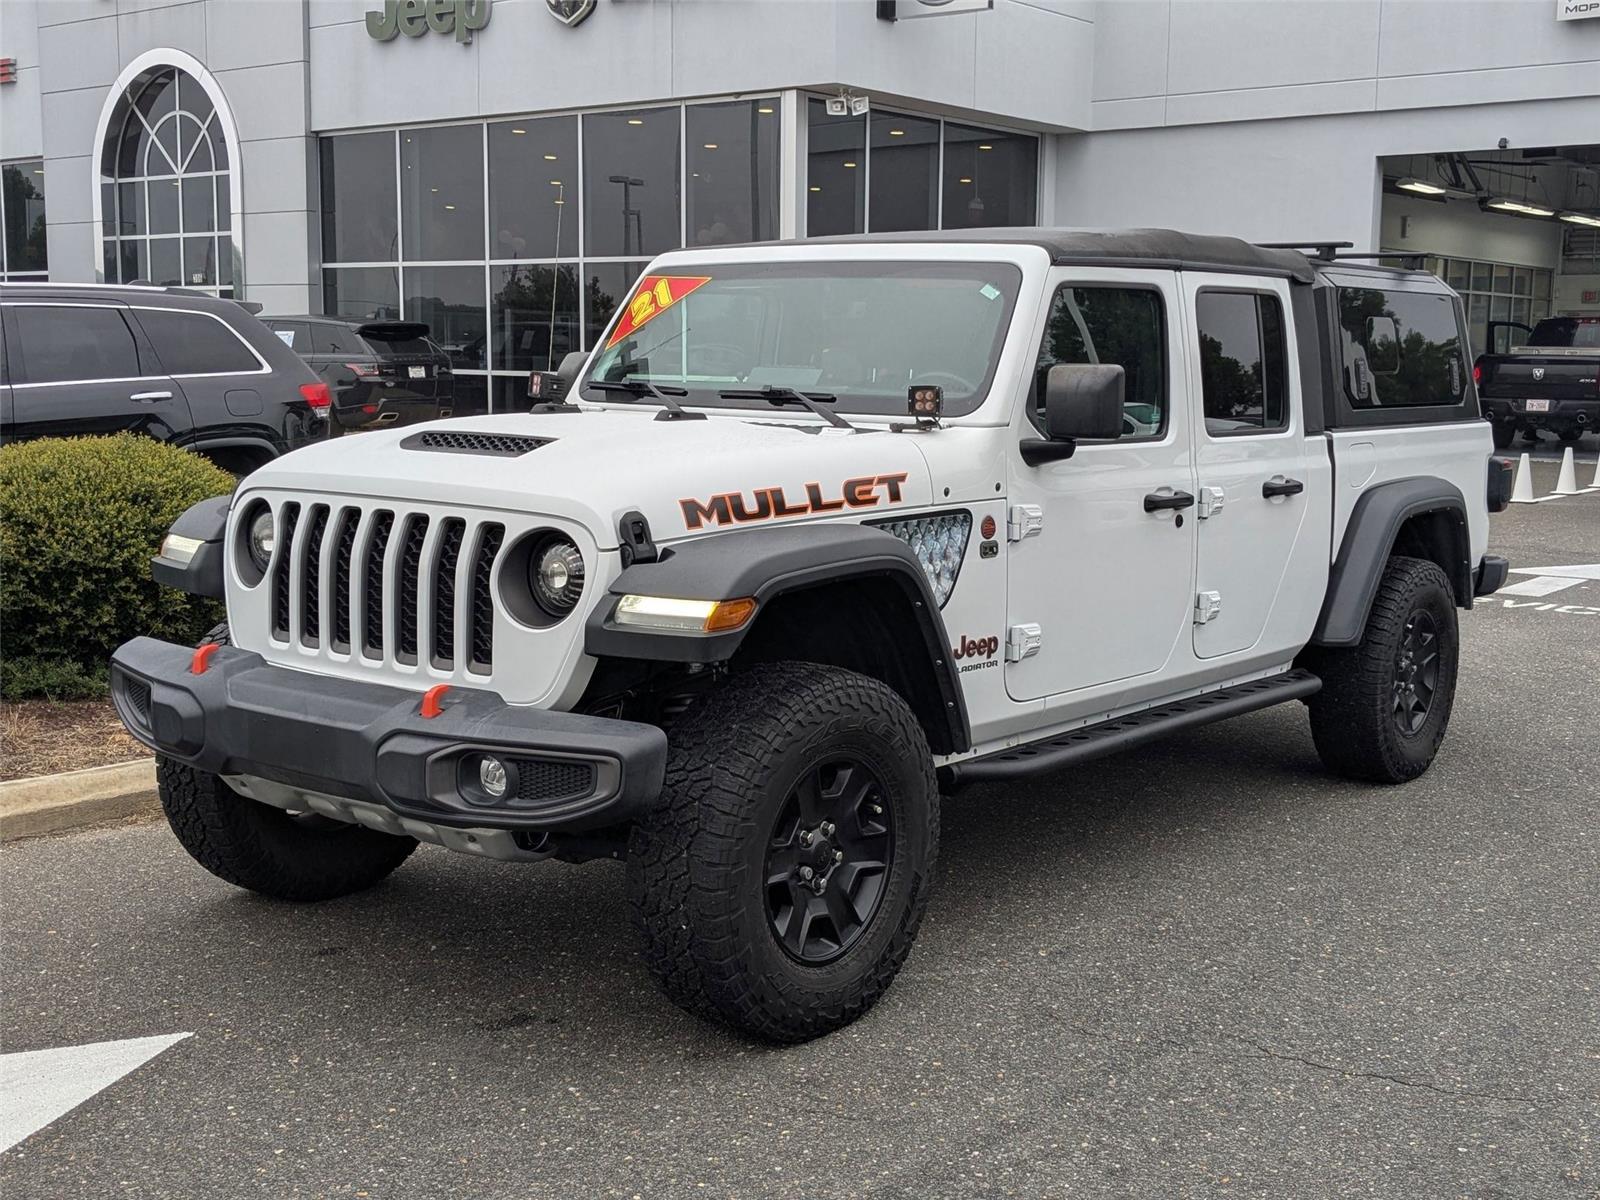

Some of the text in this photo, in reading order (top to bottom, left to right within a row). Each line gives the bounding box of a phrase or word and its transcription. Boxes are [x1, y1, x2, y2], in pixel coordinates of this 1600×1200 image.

[365, 0, 493, 45] Jeep
[630, 278, 673, 327] 21
[679, 472, 908, 530] MULLET
[953, 635, 998, 660] Jeep
